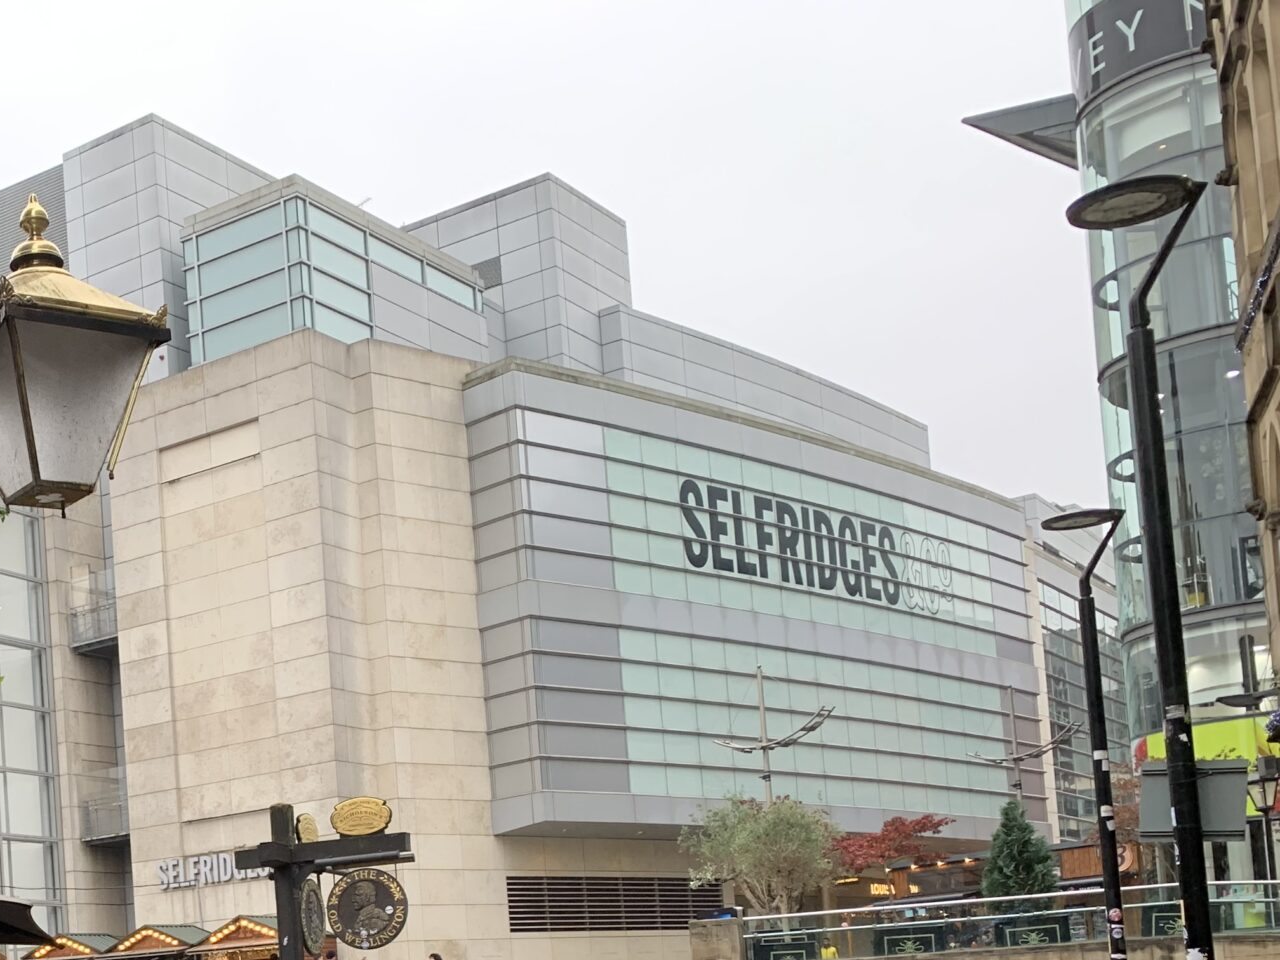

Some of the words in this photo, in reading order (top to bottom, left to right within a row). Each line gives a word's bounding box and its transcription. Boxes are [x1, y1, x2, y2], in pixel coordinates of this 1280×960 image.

[679, 479, 901, 605] SELFRIDGES
[352, 869, 377, 881] THE
[328, 910, 342, 932] OLD
[344, 905, 405, 947] WELINGTON
